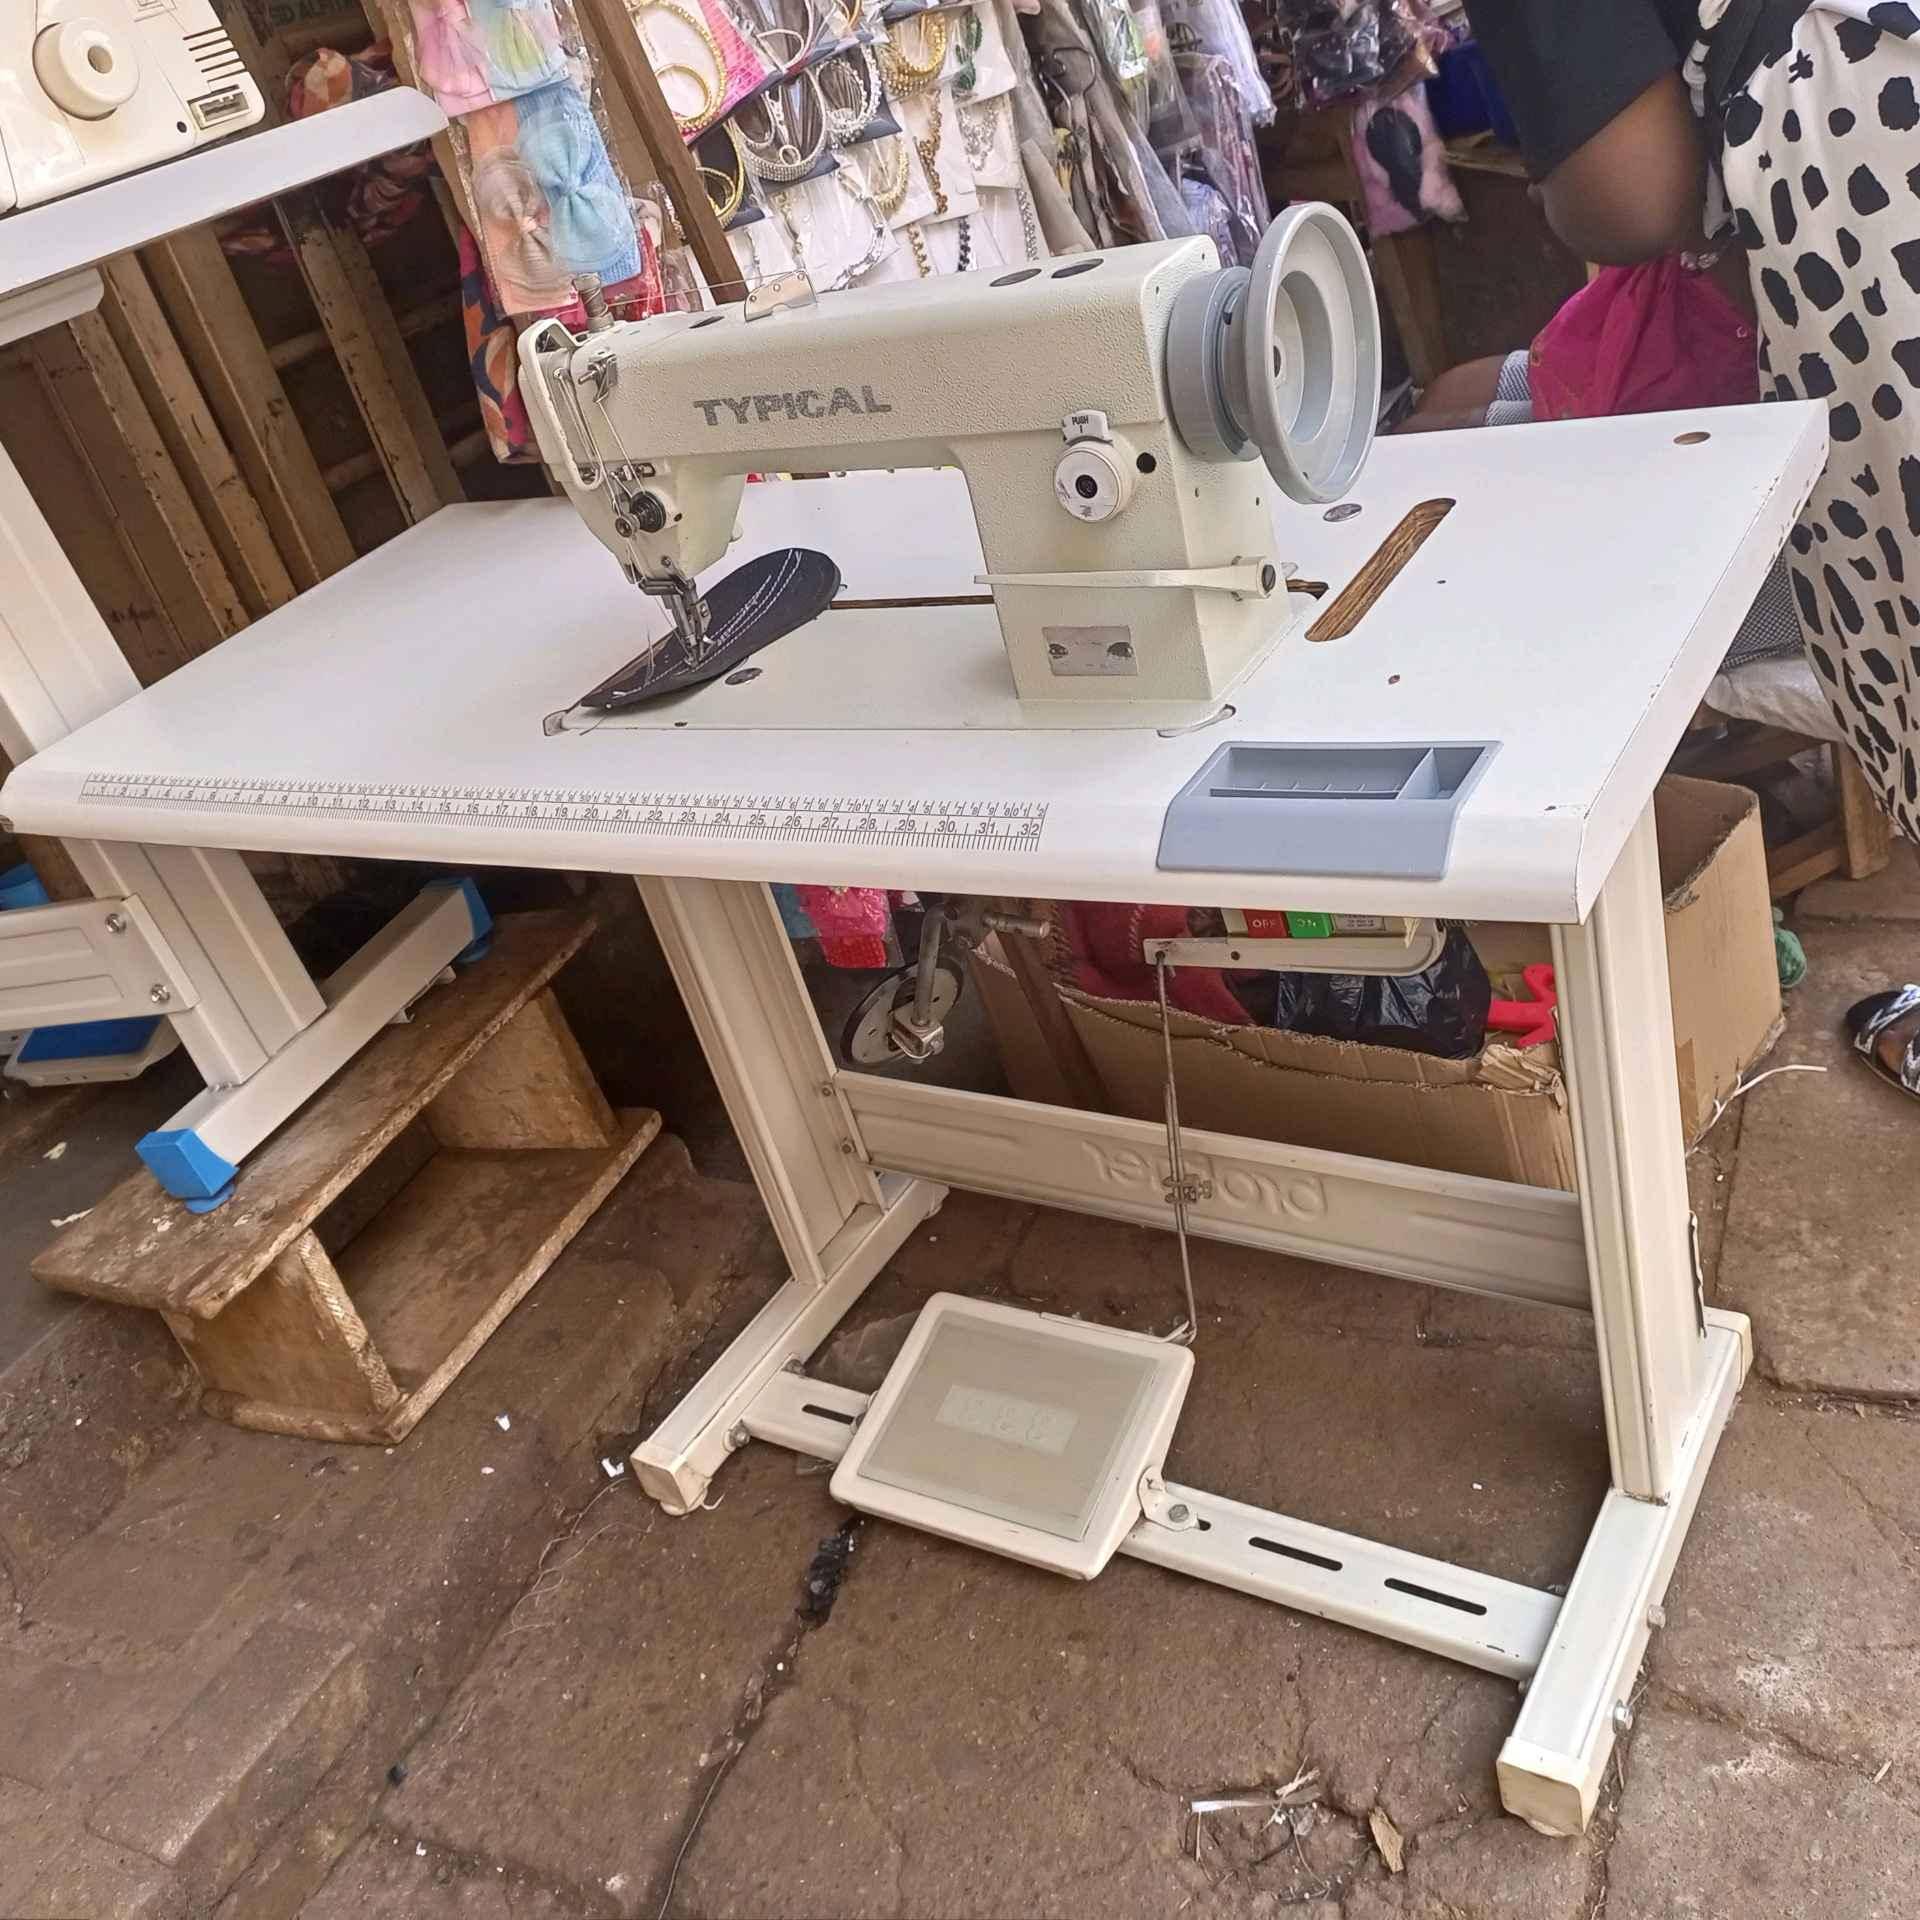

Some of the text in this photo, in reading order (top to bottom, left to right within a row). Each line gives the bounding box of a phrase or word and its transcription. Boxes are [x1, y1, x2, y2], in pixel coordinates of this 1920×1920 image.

[693, 385, 892, 426] TYPICAL
[1072, 415, 1088, 425] PUSH
[333, 798, 343, 806] 11
[359, 799, 369, 808] 12
[385, 800, 396, 809] 13
[411, 801, 423, 810] 14
[440, 802, 451, 811] 15
[467, 804, 479, 813] 16
[496, 805, 508, 814] 17
[526, 806, 538, 816] 18
[555, 807, 568, 817] 19
[584, 808, 598, 818] 20
[615, 809, 629, 819] 21
[648, 810, 662, 820] 22
[681, 812, 695, 822] 23
[714, 813, 730, 823] 24
[750, 814, 766, 825] 25
[785, 816, 801, 827] 26
[822, 817, 838, 827] 27
[859, 818, 876, 829] 28
[898, 820, 915, 831] 29
[937, 821, 955, 832] 30
[979, 822, 995, 833] 31
[1021, 824, 1039, 835] 32
